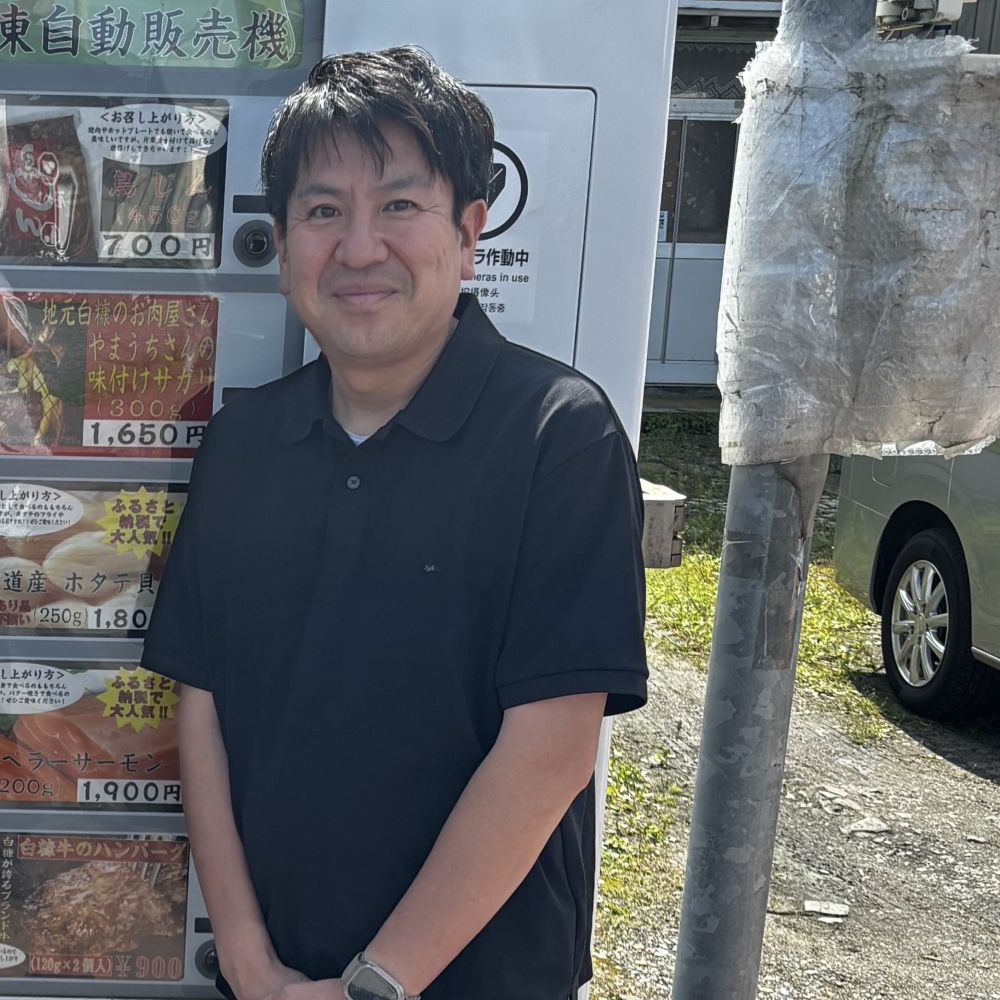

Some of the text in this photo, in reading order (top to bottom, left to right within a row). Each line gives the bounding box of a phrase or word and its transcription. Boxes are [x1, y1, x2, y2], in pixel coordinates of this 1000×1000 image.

[103, 234, 211, 257] 700円
[474, 248, 529, 267] ラ作動中
[473, 272, 529, 283] eras in use
[42, 299, 215, 328] 地元白糠のお肉屋さん
[89, 334, 215, 361] やまうちさんの
[88, 367, 215, 396] 味付けサガリ
[112, 499, 175, 514] ふるさと
[119, 514, 166, 530] 納税で
[64, 571, 156, 595] ホタテ貝
[34, 607, 88, 627] (250g)
[94, 608, 147, 629] 1,80
[112, 676, 172, 690] ふるさと
[118, 690, 164, 705] 納税で
[83, 781, 181, 802] 1,900円
[20, 837, 187, 861] 白糠牛のハンバーグ
[0, 836, 14, 942] 白糠が誇るブランド牛
